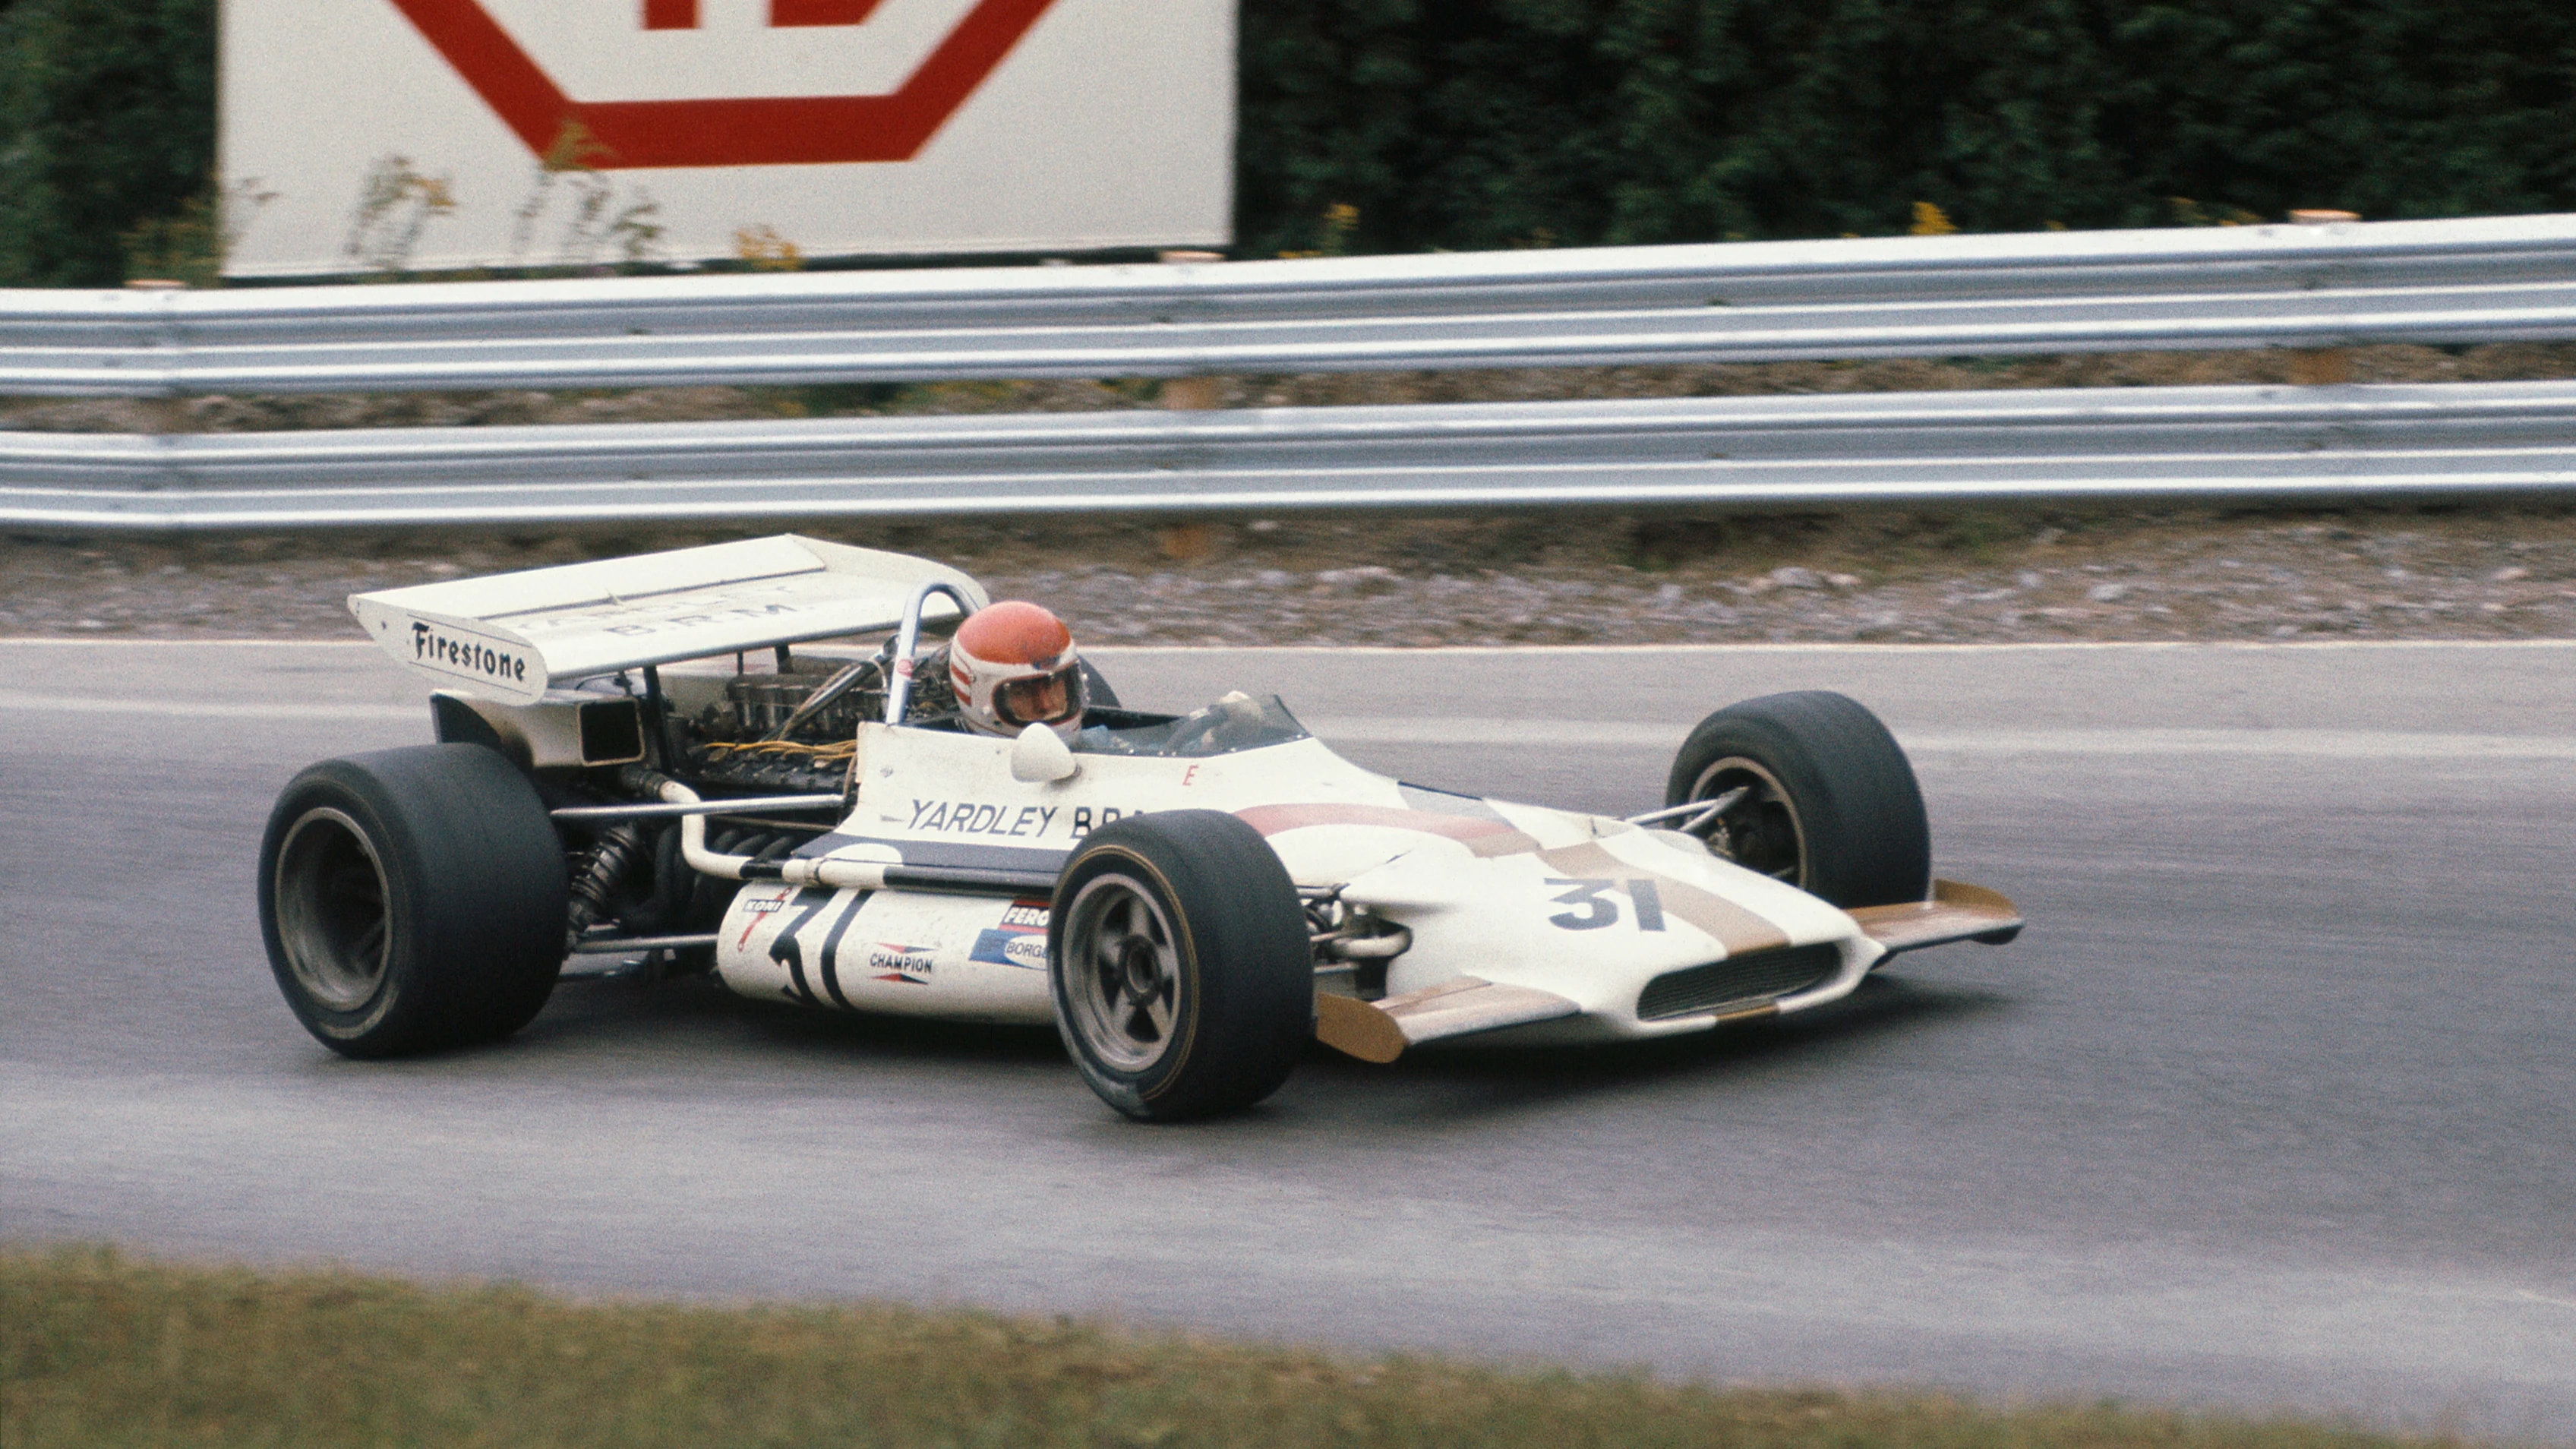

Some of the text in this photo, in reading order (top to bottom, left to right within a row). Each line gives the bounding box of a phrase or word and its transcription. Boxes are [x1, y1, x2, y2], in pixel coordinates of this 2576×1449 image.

[412, 621, 526, 683] Firestone
[1182, 765, 1200, 786] E
[908, 799, 1058, 837] YARDLEY
[744, 901, 782, 911] KONI
[1544, 877, 1666, 932] 31
[769, 887, 875, 1012] 31
[870, 953, 933, 974] CHAMPION
